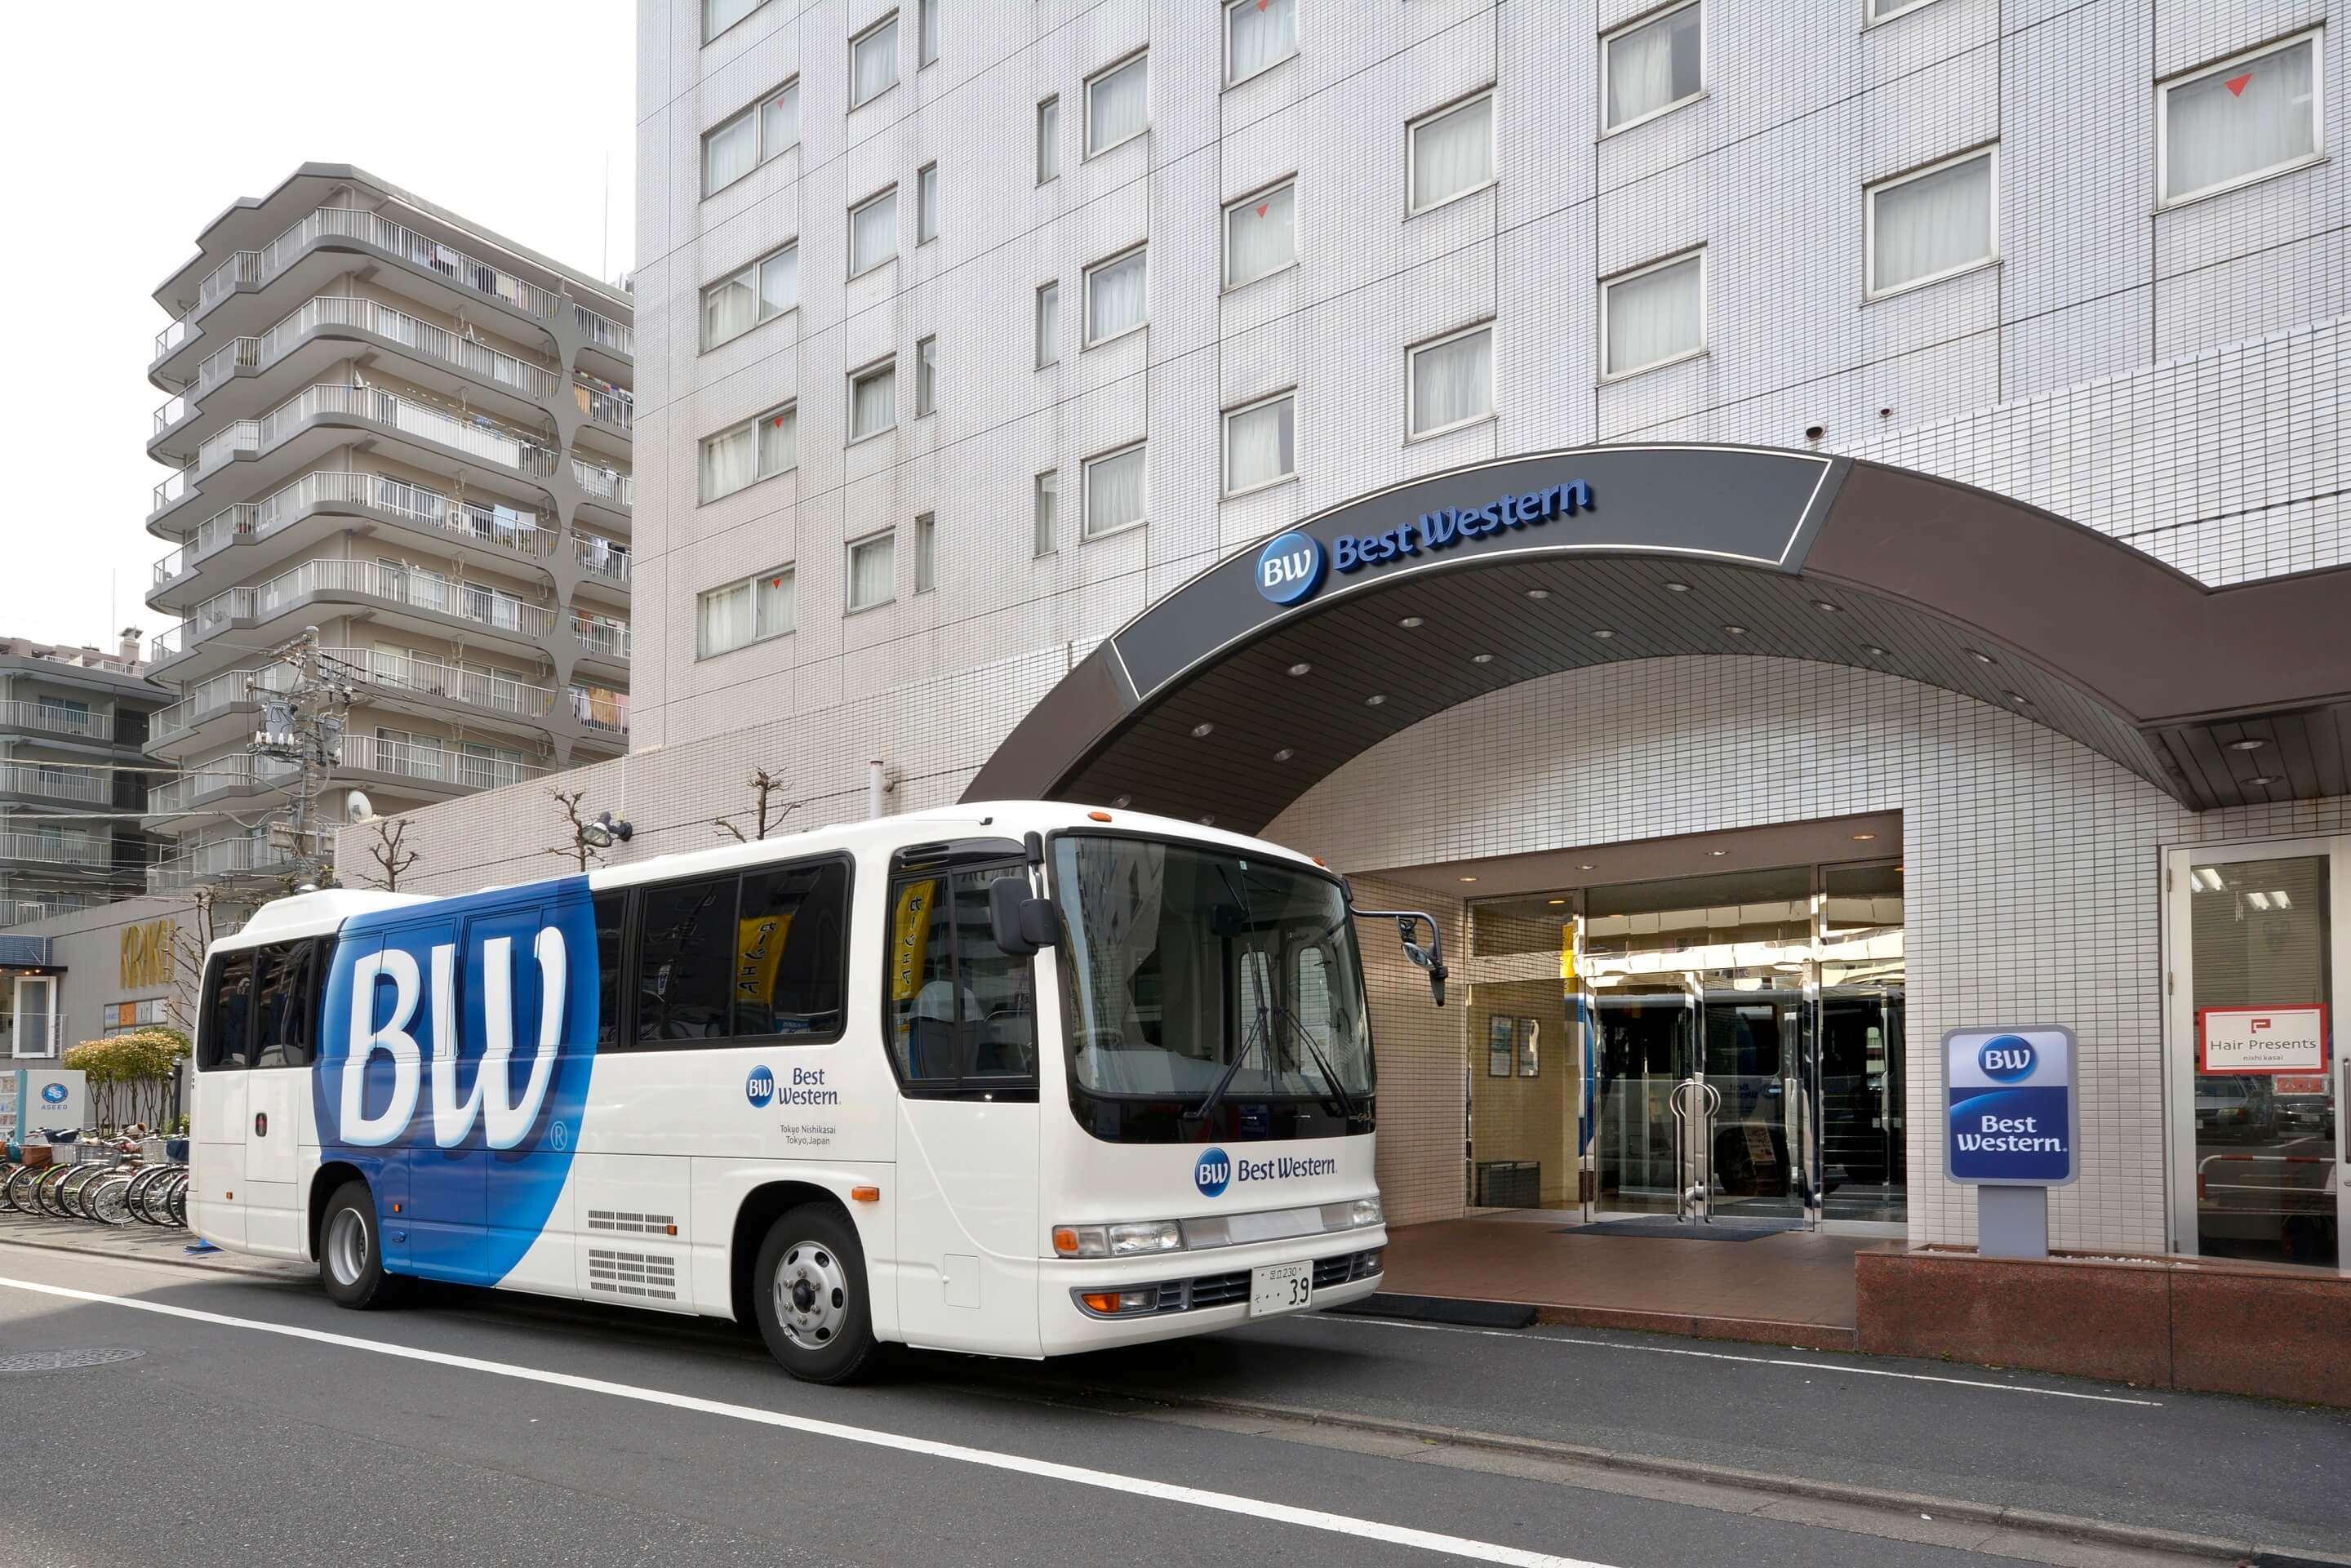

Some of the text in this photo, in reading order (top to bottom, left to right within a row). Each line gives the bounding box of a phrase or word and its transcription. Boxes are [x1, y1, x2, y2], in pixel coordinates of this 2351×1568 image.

[1264, 478, 1590, 588] BW Best Western
[340, 926, 567, 1149] BW
[2211, 1040, 2244, 1051] Hair
[1984, 1050, 2031, 1070] BW
[793, 1067, 825, 1086] Best
[749, 1079, 772, 1097] BW
[778, 1087, 838, 1105] Western
[780, 1125, 836, 1135] Tokyo Nishikasai
[1981, 1115, 2038, 1133] Best
[1958, 1133, 2061, 1153] Western
[1198, 1157, 1335, 1185] BW Best Western
